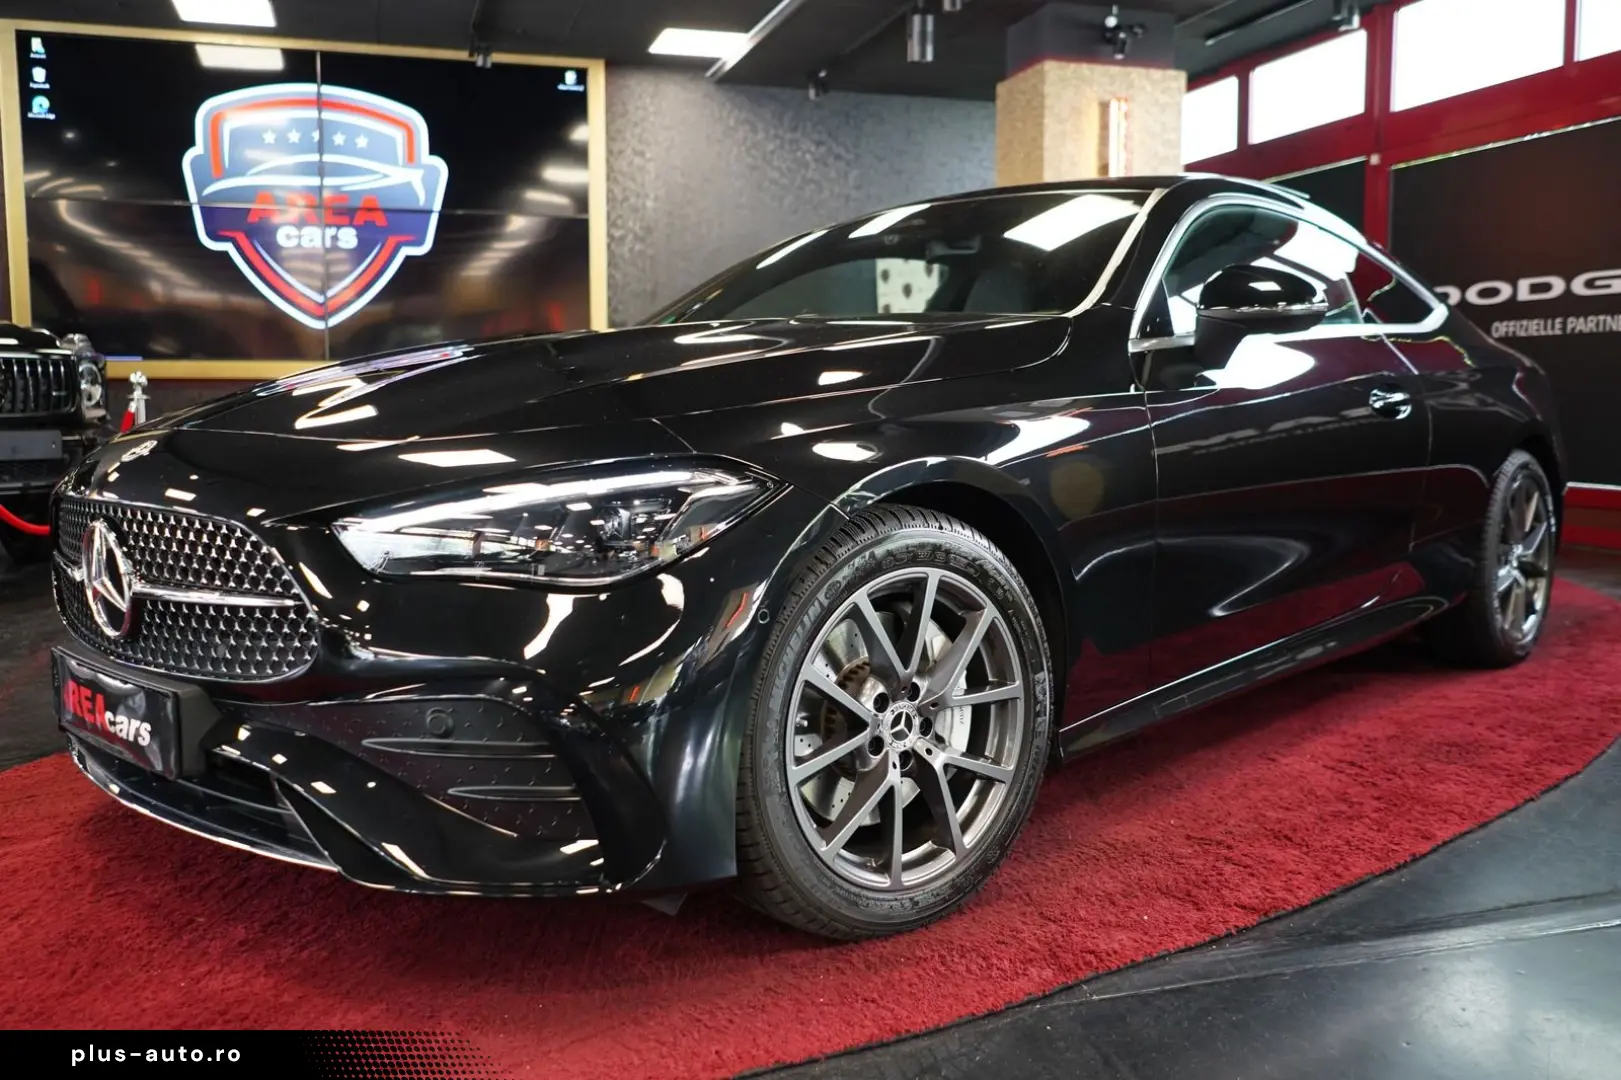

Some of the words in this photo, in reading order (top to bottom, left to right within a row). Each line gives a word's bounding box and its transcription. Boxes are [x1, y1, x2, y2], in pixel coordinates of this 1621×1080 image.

[247, 191, 388, 226] AREA
[275, 225, 358, 249] cars
[1491, 317, 1563, 338] OFFIZIELLE
